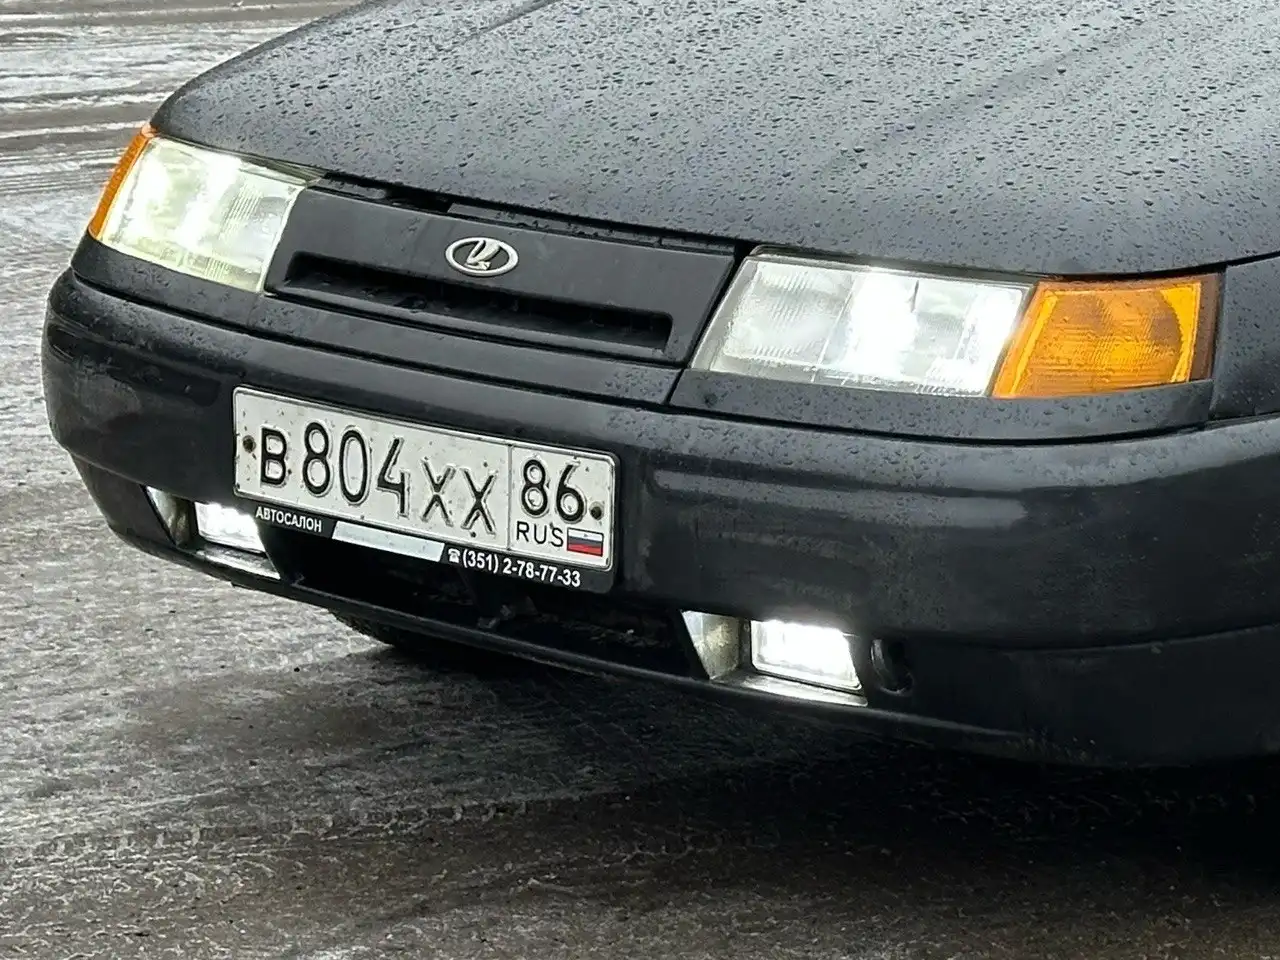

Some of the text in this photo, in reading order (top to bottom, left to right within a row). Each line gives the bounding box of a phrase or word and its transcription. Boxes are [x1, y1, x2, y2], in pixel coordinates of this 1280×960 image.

[260, 421, 585, 536] В804ХХ 86
[255, 505, 322, 533] АВТОСАЛОН
[516, 520, 565, 548] RUS
[462, 548, 581, 588] (351) 2-78-77-33
